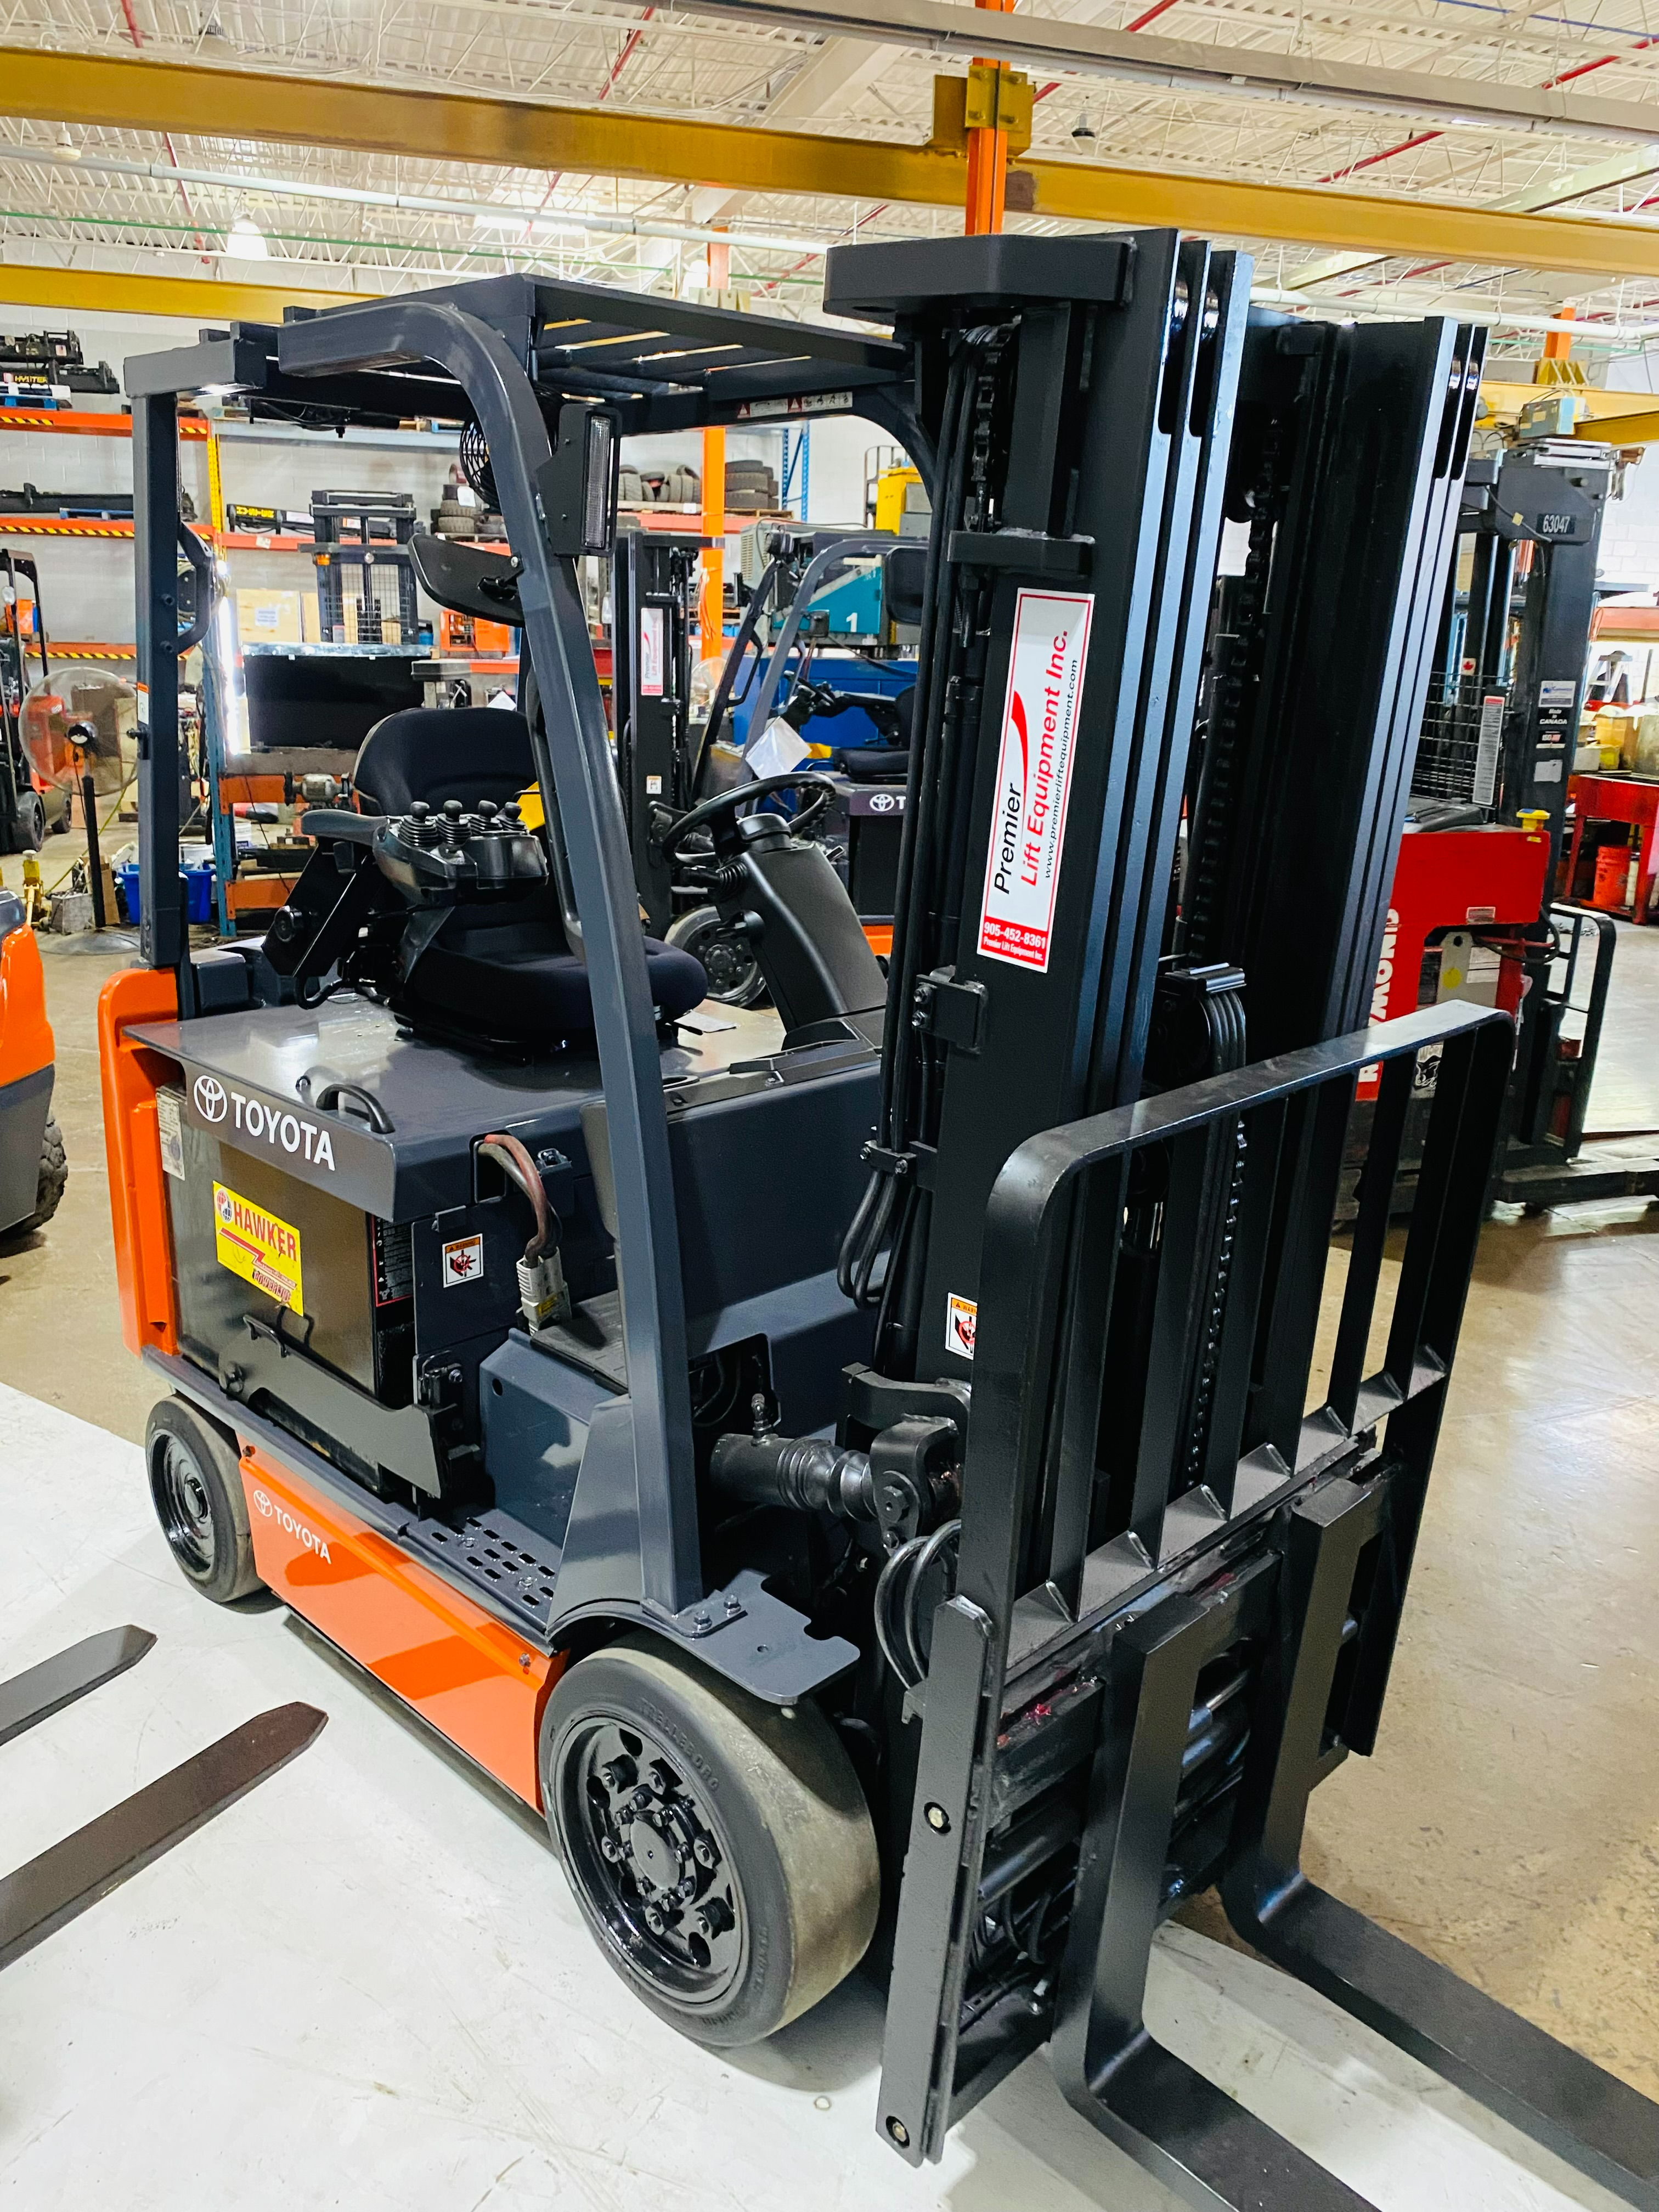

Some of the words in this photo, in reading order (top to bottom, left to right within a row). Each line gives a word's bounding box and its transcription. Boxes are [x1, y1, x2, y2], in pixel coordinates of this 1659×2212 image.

[1543, 515, 1570, 533] 63047
[846, 612, 857, 633] 1
[1046, 630, 1068, 679] Inc.
[1026, 687, 1061, 836] Equipment
[1045, 659, 1078, 878] www.premierliftequipment.com
[994, 782, 1022, 894] Premier
[1020, 843, 1041, 887] Lift
[983, 935, 1002, 949] Premier
[1001, 940, 1011, 952] Lift
[1010, 943, 1035, 958] Equipment
[1034, 950, 1043, 961] Inc.
[984, 921, 1046, 950] 905-452-8361
[1358, 909, 1399, 1082] RMOND
[230, 1092, 336, 1171] TOYOTA
[234, 1200, 297, 1262] HAWKER
[274, 1504, 331, 1564] TOYOTA
